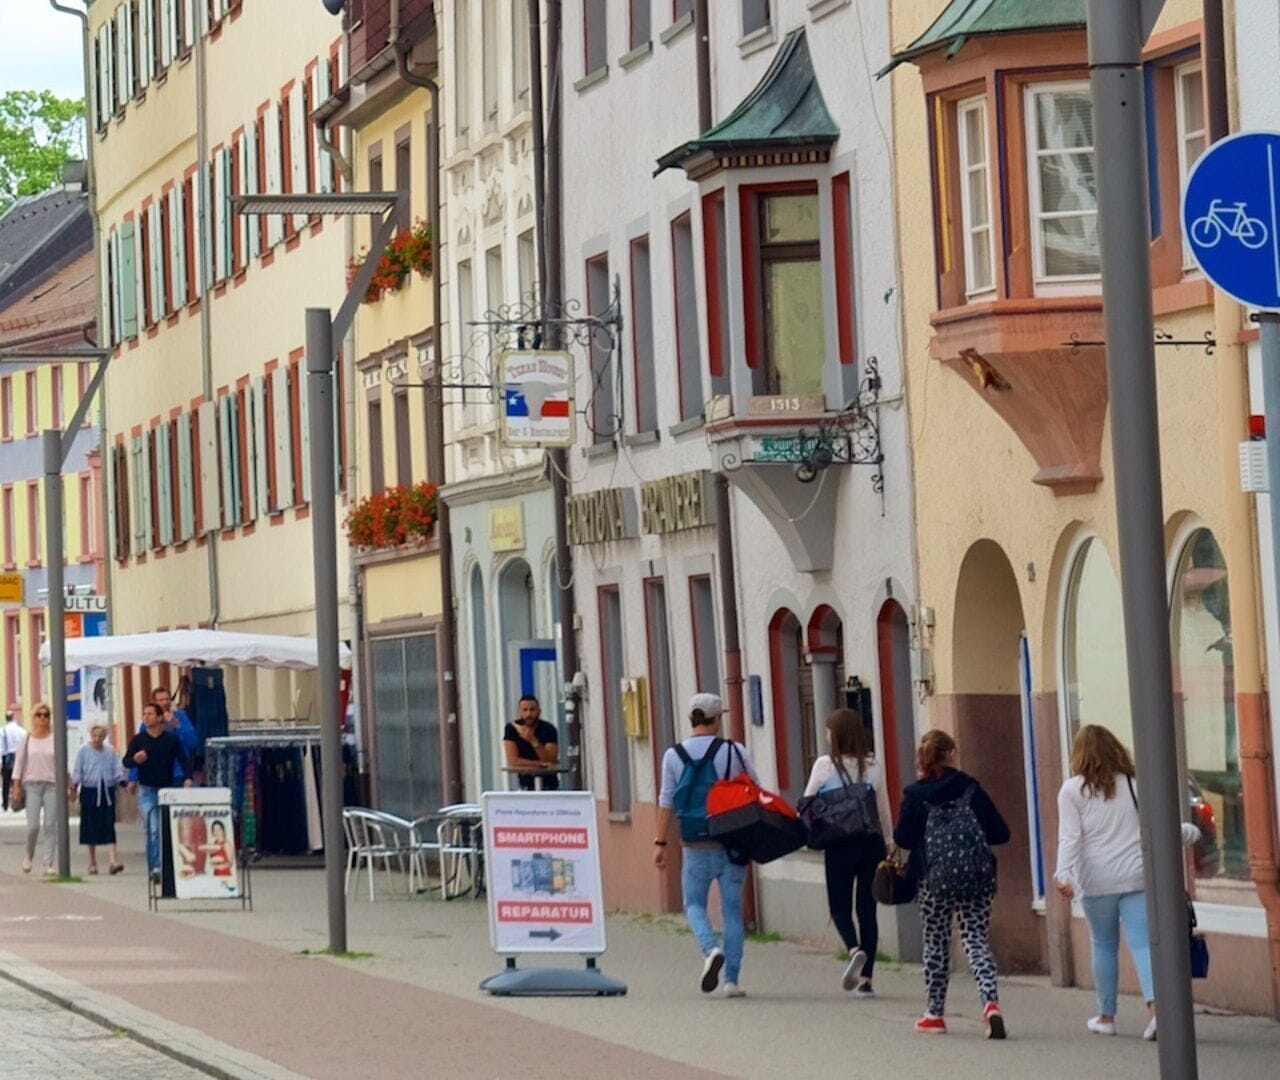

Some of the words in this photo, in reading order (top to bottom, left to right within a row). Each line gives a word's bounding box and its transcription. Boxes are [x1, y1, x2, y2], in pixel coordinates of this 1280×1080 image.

[565, 487, 625, 546] FORTUNA
[640, 470, 706, 535] BRAUEREI
[64, 596, 107, 610] ULTU
[497, 831, 586, 844] SMARTPHONE
[501, 905, 590, 919] REPARATUR
